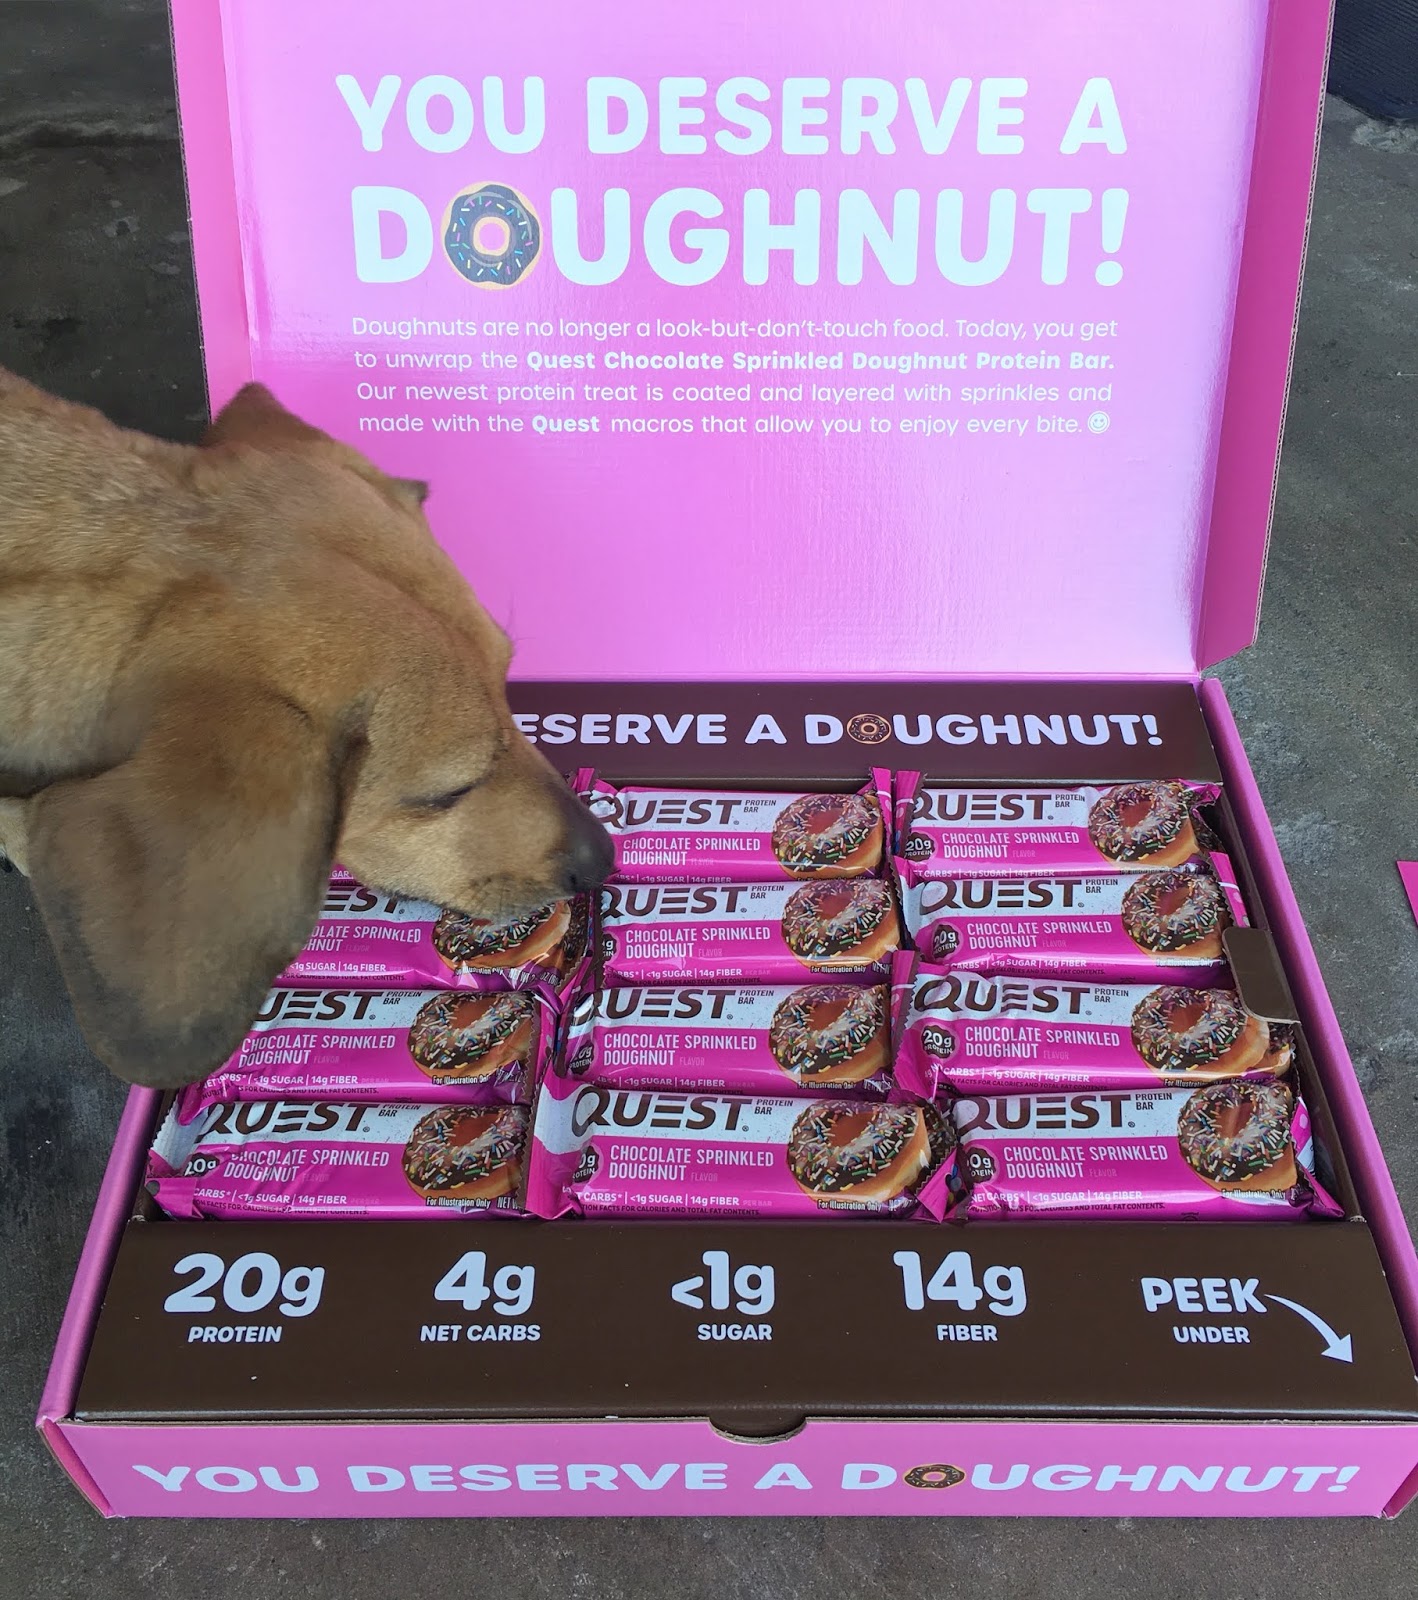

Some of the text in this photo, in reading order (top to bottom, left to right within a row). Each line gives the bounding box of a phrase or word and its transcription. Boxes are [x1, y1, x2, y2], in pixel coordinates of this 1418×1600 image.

[336, 75, 1128, 156] YOU DESERVE A
[352, 316, 478, 341] Doughnuts
[482, 321, 520, 337] are
[525, 321, 554, 337] no
[559, 317, 632, 342] longer
[635, 321, 651, 338] a
[892, 318, 949, 338] food.
[955, 318, 1027, 341] Today,
[1032, 322, 1074, 341] you
[1079, 319, 1119, 342] get
[353, 349, 1115, 375] to unwrap the Quest Chocolate Sprinkled Doughnut Protein Bar.
[356, 381, 1113, 406] Our newest protein treat is coated and layered with sprinkles and
[359, 413, 1083, 437] made with the Quest macros that allow you to enjoy every bite.
[511, 713, 728, 745] ESERVE
[745, 713, 788, 745] A
[1055, 794, 1085, 802] PROTEIN
[589, 796, 742, 829] QUEST
[914, 794, 1052, 821] QUEST
[623, 838, 760, 850] CHOCOLATE SPRINKLED
[942, 832, 1079, 844] CHOCOLATE SPRINKLED
[623, 851, 687, 865] DOUGHNUT
[944, 845, 1008, 858] DOUGHNUT
[920, 880, 1082, 915] QUEST
[312, 926, 421, 942] OLATE SPRINKLED
[626, 927, 770, 943] CHOCOLATE SPRINKLED
[967, 921, 1112, 935] CHOCOLATE SPRINKLED
[626, 943, 694, 959] DOUGHNUT
[969, 936, 1037, 950] DOUGHNUT
[343, 964, 358, 972] 14g
[663, 970, 692, 978] SUGAR
[383, 997, 400, 1005] BAR
[913, 976, 1091, 1014] QUEST
[1095, 988, 1129, 997] PROTEIN
[1095, 995, 1111, 1003] BAR
[255, 990, 384, 1022] UEST
[242, 1034, 396, 1053] CHOCOLATE SPRINKLED
[604, 1034, 757, 1050] CHOCOLATE SPRINKLED
[923, 1030, 952, 1048] 20g
[965, 1027, 1120, 1046] CHOCOLATE SPRINKLED
[239, 1050, 311, 1068] DOUGHNUT
[604, 1050, 675, 1066] DOUGHNUT
[966, 1043, 1039, 1059] DOUGHNUT
[1136, 1093, 1172, 1101] PROTEIN
[1136, 1102, 1154, 1110] BAR
[379, 1109, 397, 1117] BAR
[572, 1087, 752, 1137] QUEST
[754, 1106, 772, 1115] BAR
[959, 1094, 1132, 1136] QUEST
[311, 1150, 389, 1166] SPRINKLED
[610, 1145, 774, 1166] CHOCOLATE SPRINKLED
[1004, 1145, 1168, 1162] CHOCOLATE SPRINKLED
[224, 1162, 299, 1182] DOUGHNUT
[609, 1163, 718, 1182] DOUGHNUT FLAVOR
[1007, 1162, 1084, 1178] DOUGHNUT
[649, 1194, 683, 1204] SUGAR
[691, 1195, 708, 1205] 14g
[711, 1196, 739, 1205] FIBER
[163, 1252, 326, 1318] 20g
[434, 1251, 536, 1317] 4g
[671, 1250, 775, 1316] <1g
[893, 1250, 1027, 1317] 14g
[1141, 1277, 1267, 1314] PEEK
[187, 1325, 283, 1343] PROTEIN
[420, 1324, 541, 1342] NET CARBS
[697, 1323, 773, 1342] SUGAR
[936, 1324, 998, 1342] FIBER
[1173, 1326, 1251, 1344] UNDER
[132, 1464, 320, 1493] YOU
[346, 1462, 728, 1493] DESERVE
[753, 1462, 813, 1491] A
